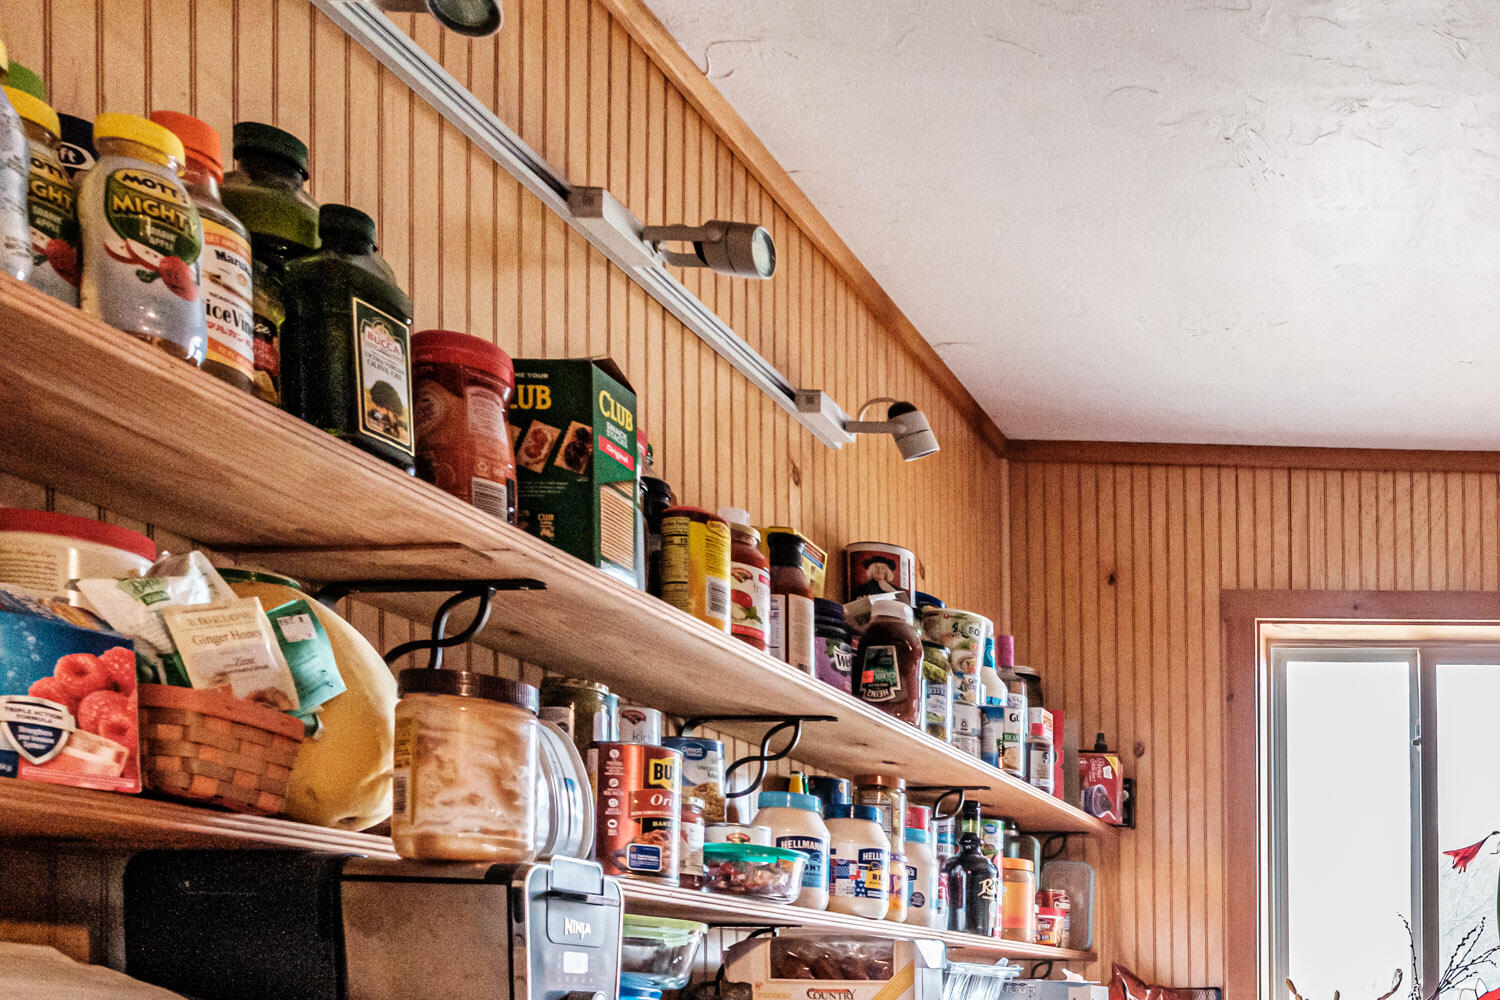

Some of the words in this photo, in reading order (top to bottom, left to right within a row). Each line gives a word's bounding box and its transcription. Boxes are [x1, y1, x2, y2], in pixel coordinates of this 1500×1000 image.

[598, 389, 634, 432] CLUB
[191, 631, 229, 646] Ginger
[564, 916, 591, 940] NINJA
[806, 987, 857, 1000] COUNTRY
